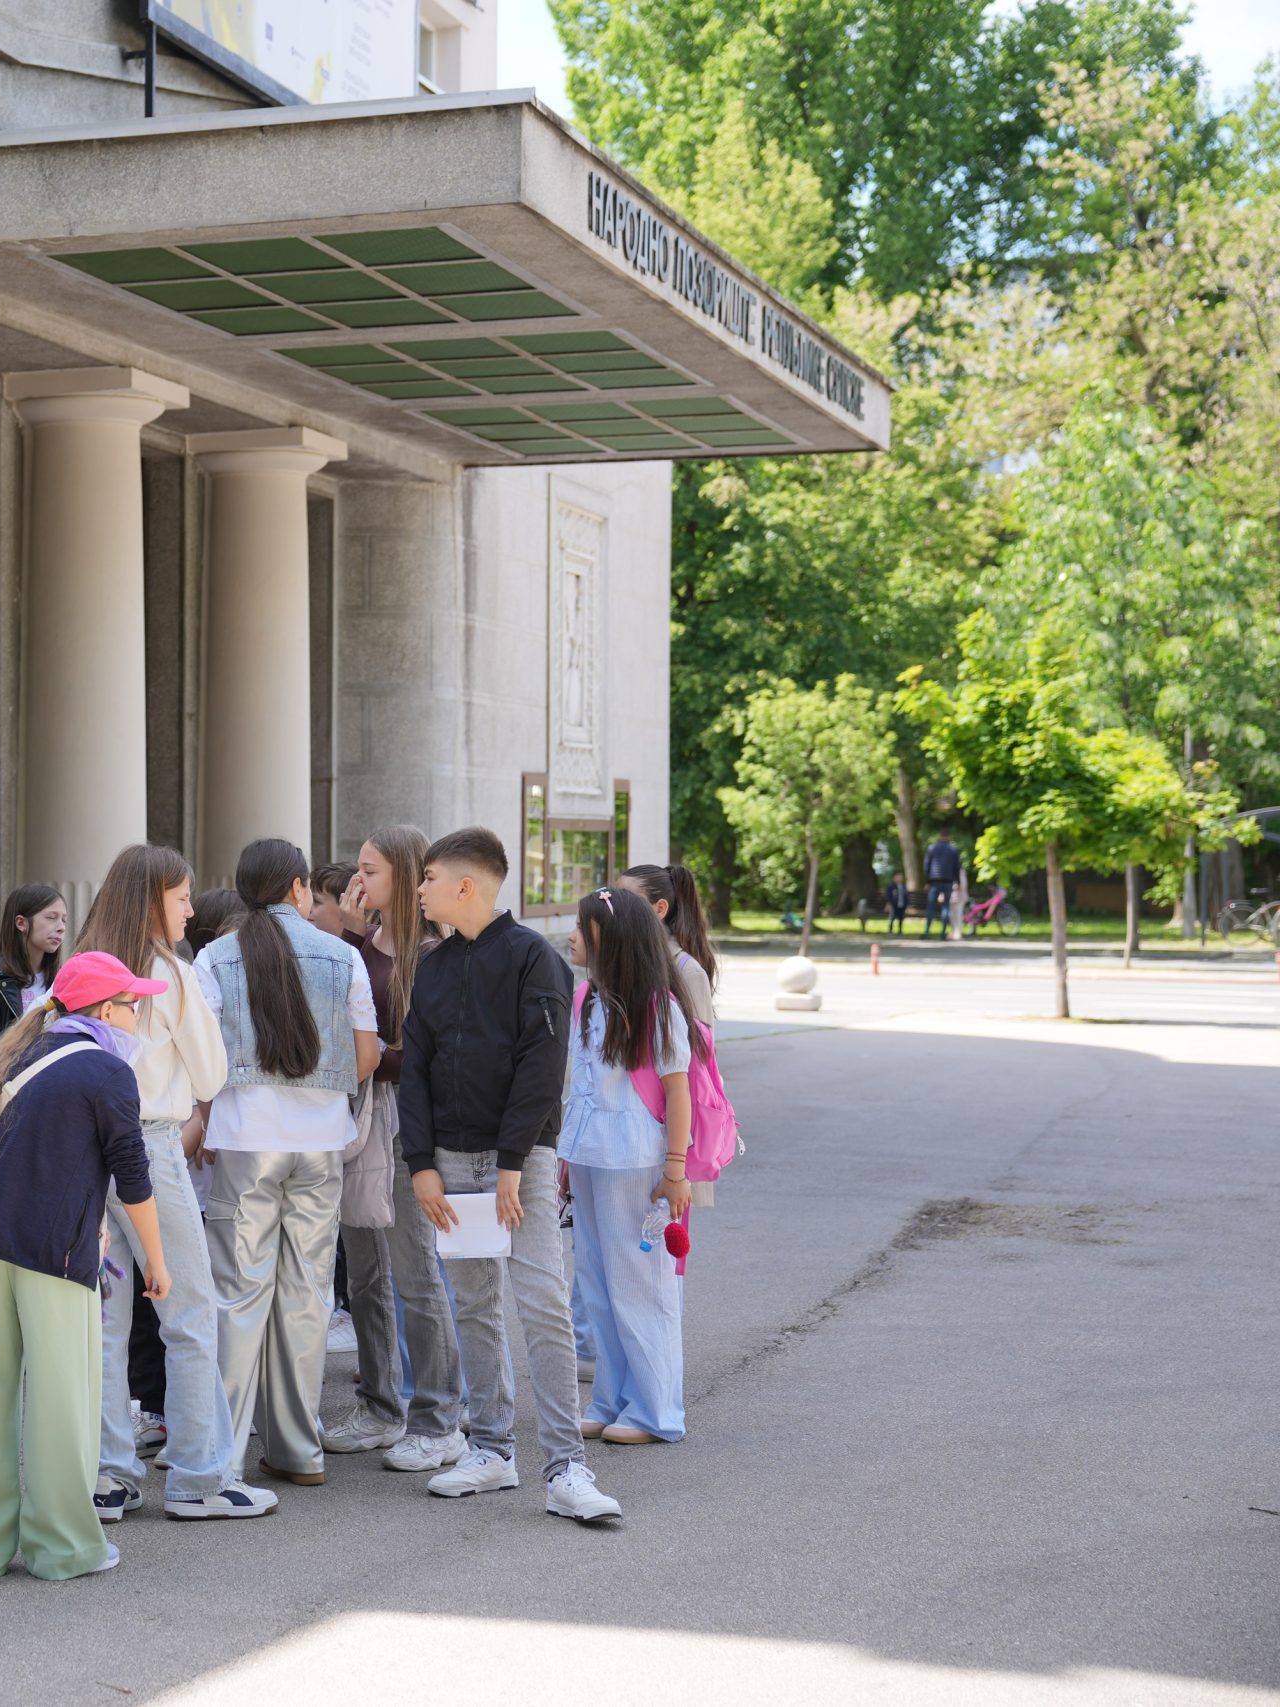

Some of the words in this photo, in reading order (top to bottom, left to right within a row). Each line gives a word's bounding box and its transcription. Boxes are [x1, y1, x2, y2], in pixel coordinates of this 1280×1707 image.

[588, 172, 669, 283] НАРОДНО
[672, 236, 757, 346] ПОЗОРИШТЕ
[761, 305, 826, 395] РЕПУБЛИКЕ
[826, 356, 865, 422] СРПСКЕ
